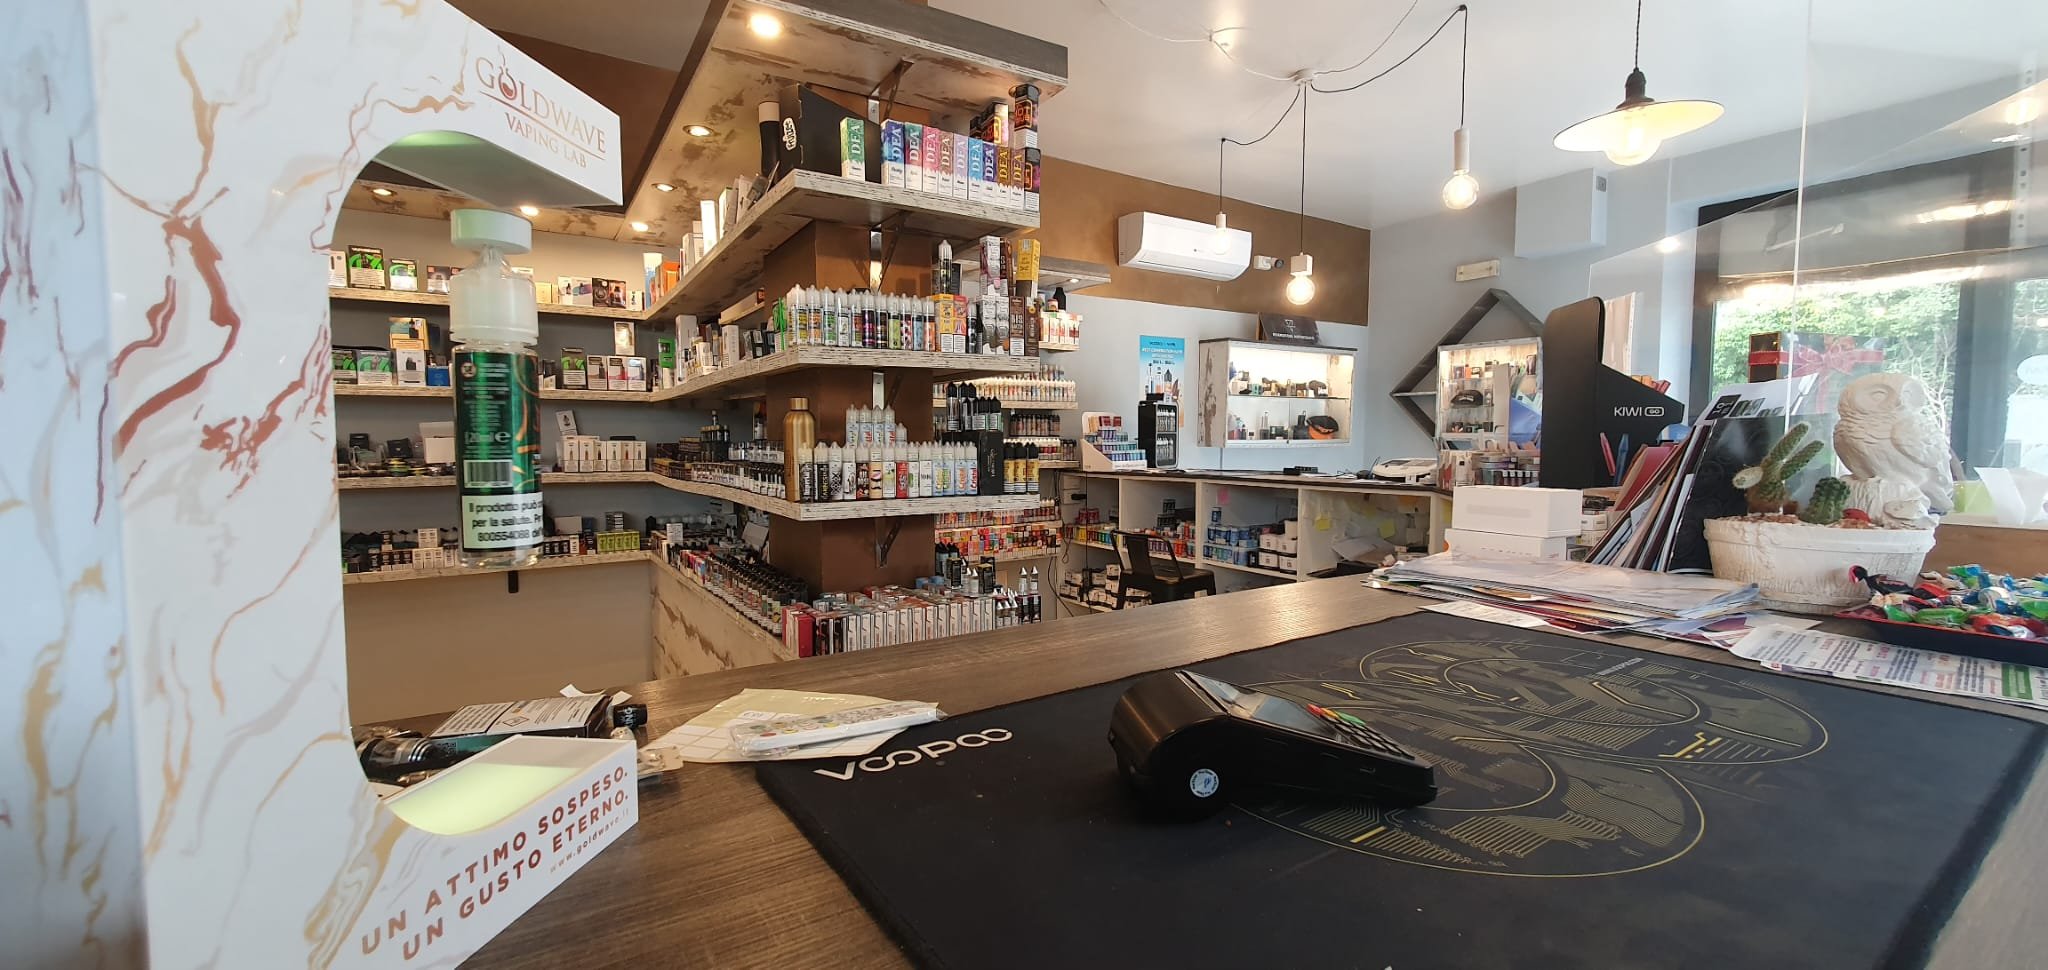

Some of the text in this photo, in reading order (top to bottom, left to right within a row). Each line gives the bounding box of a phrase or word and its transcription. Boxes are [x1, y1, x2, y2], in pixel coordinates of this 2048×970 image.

[475, 56, 606, 154] GOLDWAVE
[505, 112, 588, 169] VAPING LAB
[851, 125, 862, 155] DEA
[891, 128, 904, 158] DEA
[910, 130, 920, 161] DEA
[926, 132, 936, 162] DEA
[941, 138, 950, 166] DEA
[957, 140, 966, 168] DEA
[972, 143, 981, 172] DEA
[985, 148, 994, 178] DEA
[1000, 151, 1008, 179] DEA
[1014, 154, 1022, 181] DEA
[1614, 406, 1642, 417] KIWI
[472, 518, 487, 530] per
[490, 517, 499, 527] la
[476, 502, 519, 515] prodotto
[814, 727, 1013, 782] VOOPOO
[550, 807, 630, 875] www.goldwave.it
[361, 765, 628, 956] UN ATTIMO SOSPESO.
[403, 789, 629, 961] UN GUSTO ETERNO.
